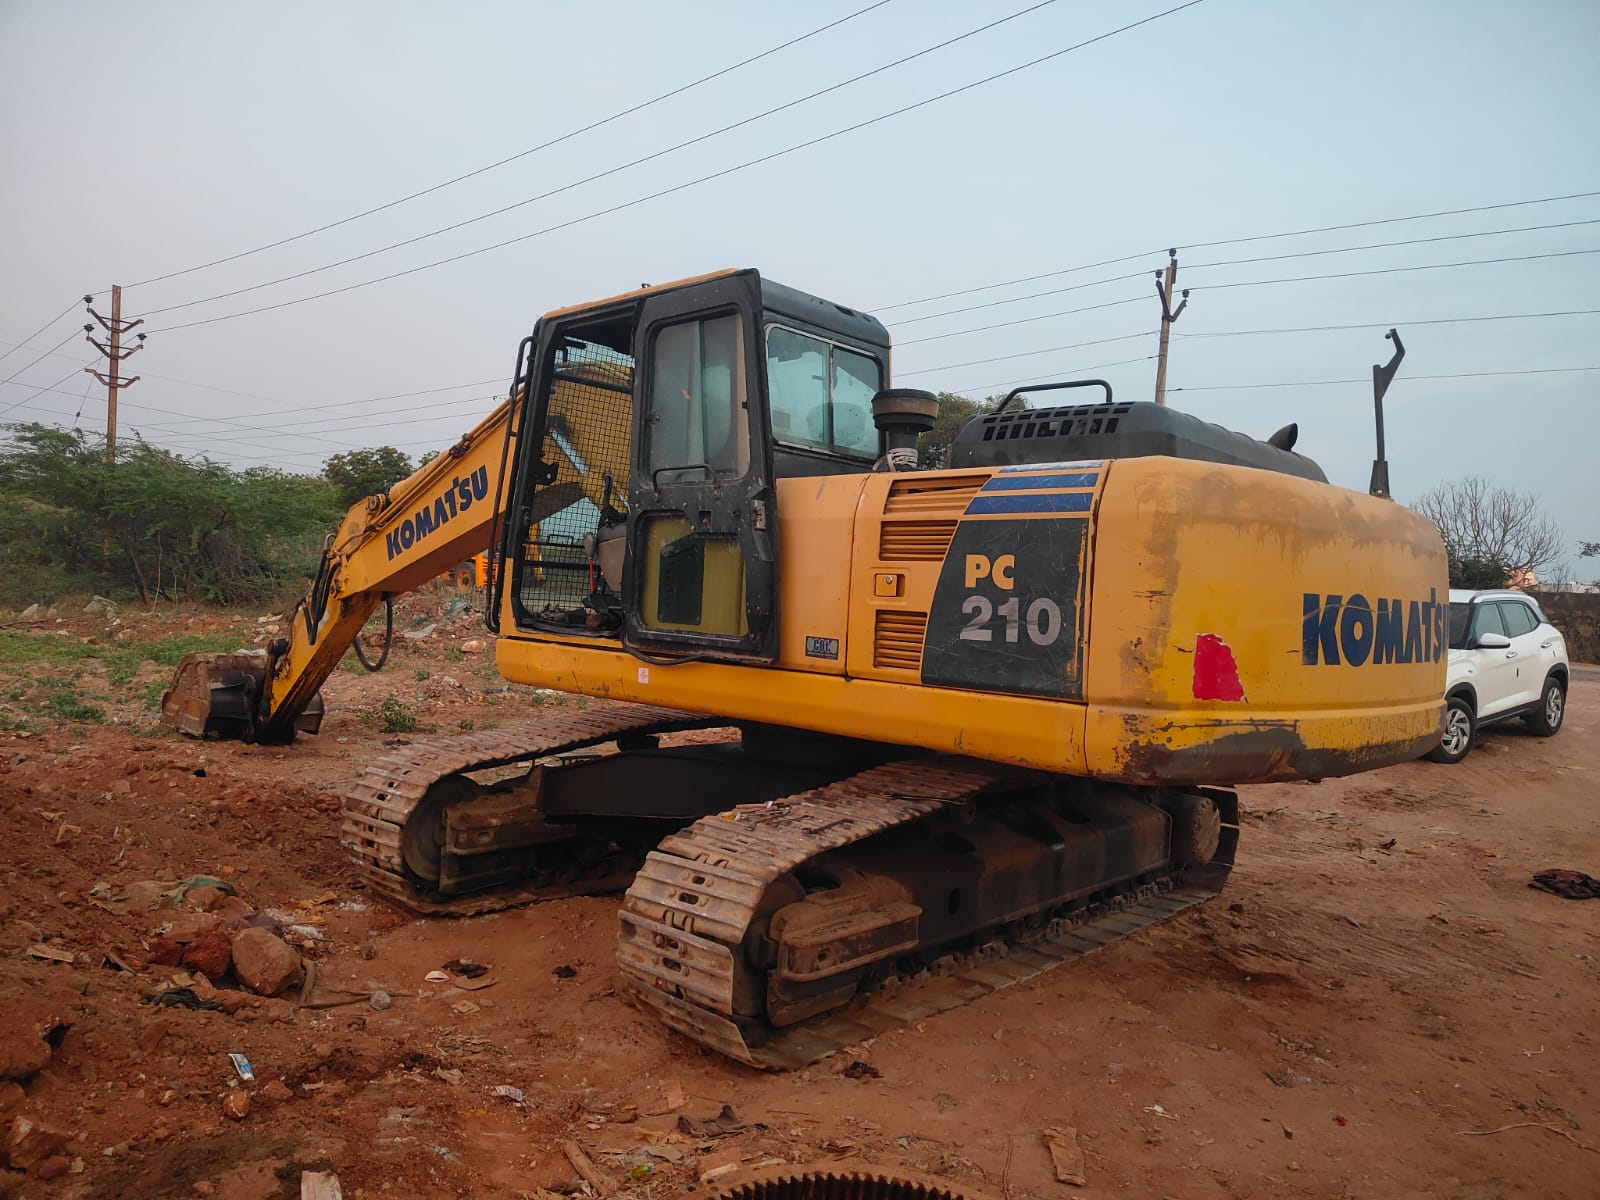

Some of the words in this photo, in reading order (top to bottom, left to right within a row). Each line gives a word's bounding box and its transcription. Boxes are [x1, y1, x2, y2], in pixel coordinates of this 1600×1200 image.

[385, 464, 489, 561] KOMATSU
[964, 554, 1015, 590] PC
[960, 595, 1062, 646] 210
